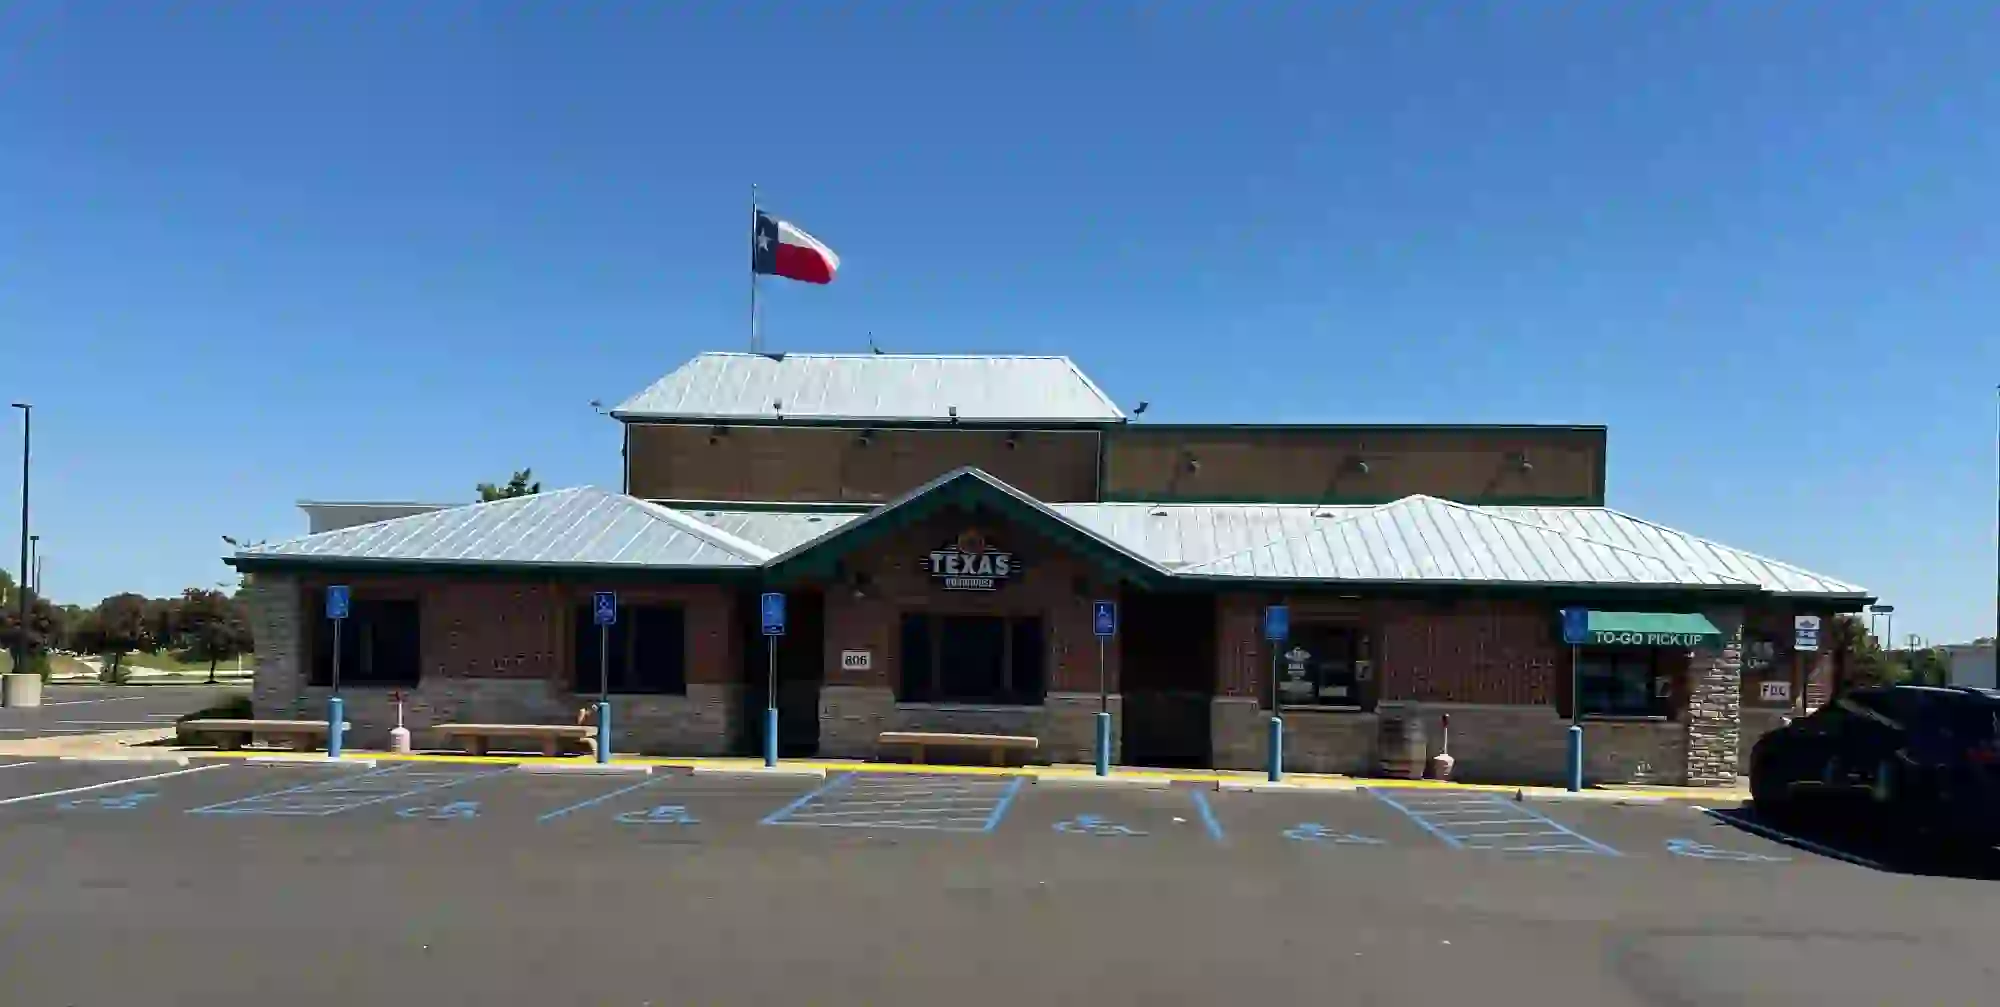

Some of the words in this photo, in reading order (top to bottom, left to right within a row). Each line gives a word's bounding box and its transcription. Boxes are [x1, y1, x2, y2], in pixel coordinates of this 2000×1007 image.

[930, 553, 1009, 576] TEXAS
[1595, 631, 1643, 645] TO-GO
[1647, 633, 1681, 646] PICK
[1683, 634, 1703, 646] UP
[845, 655, 867, 667] 806
